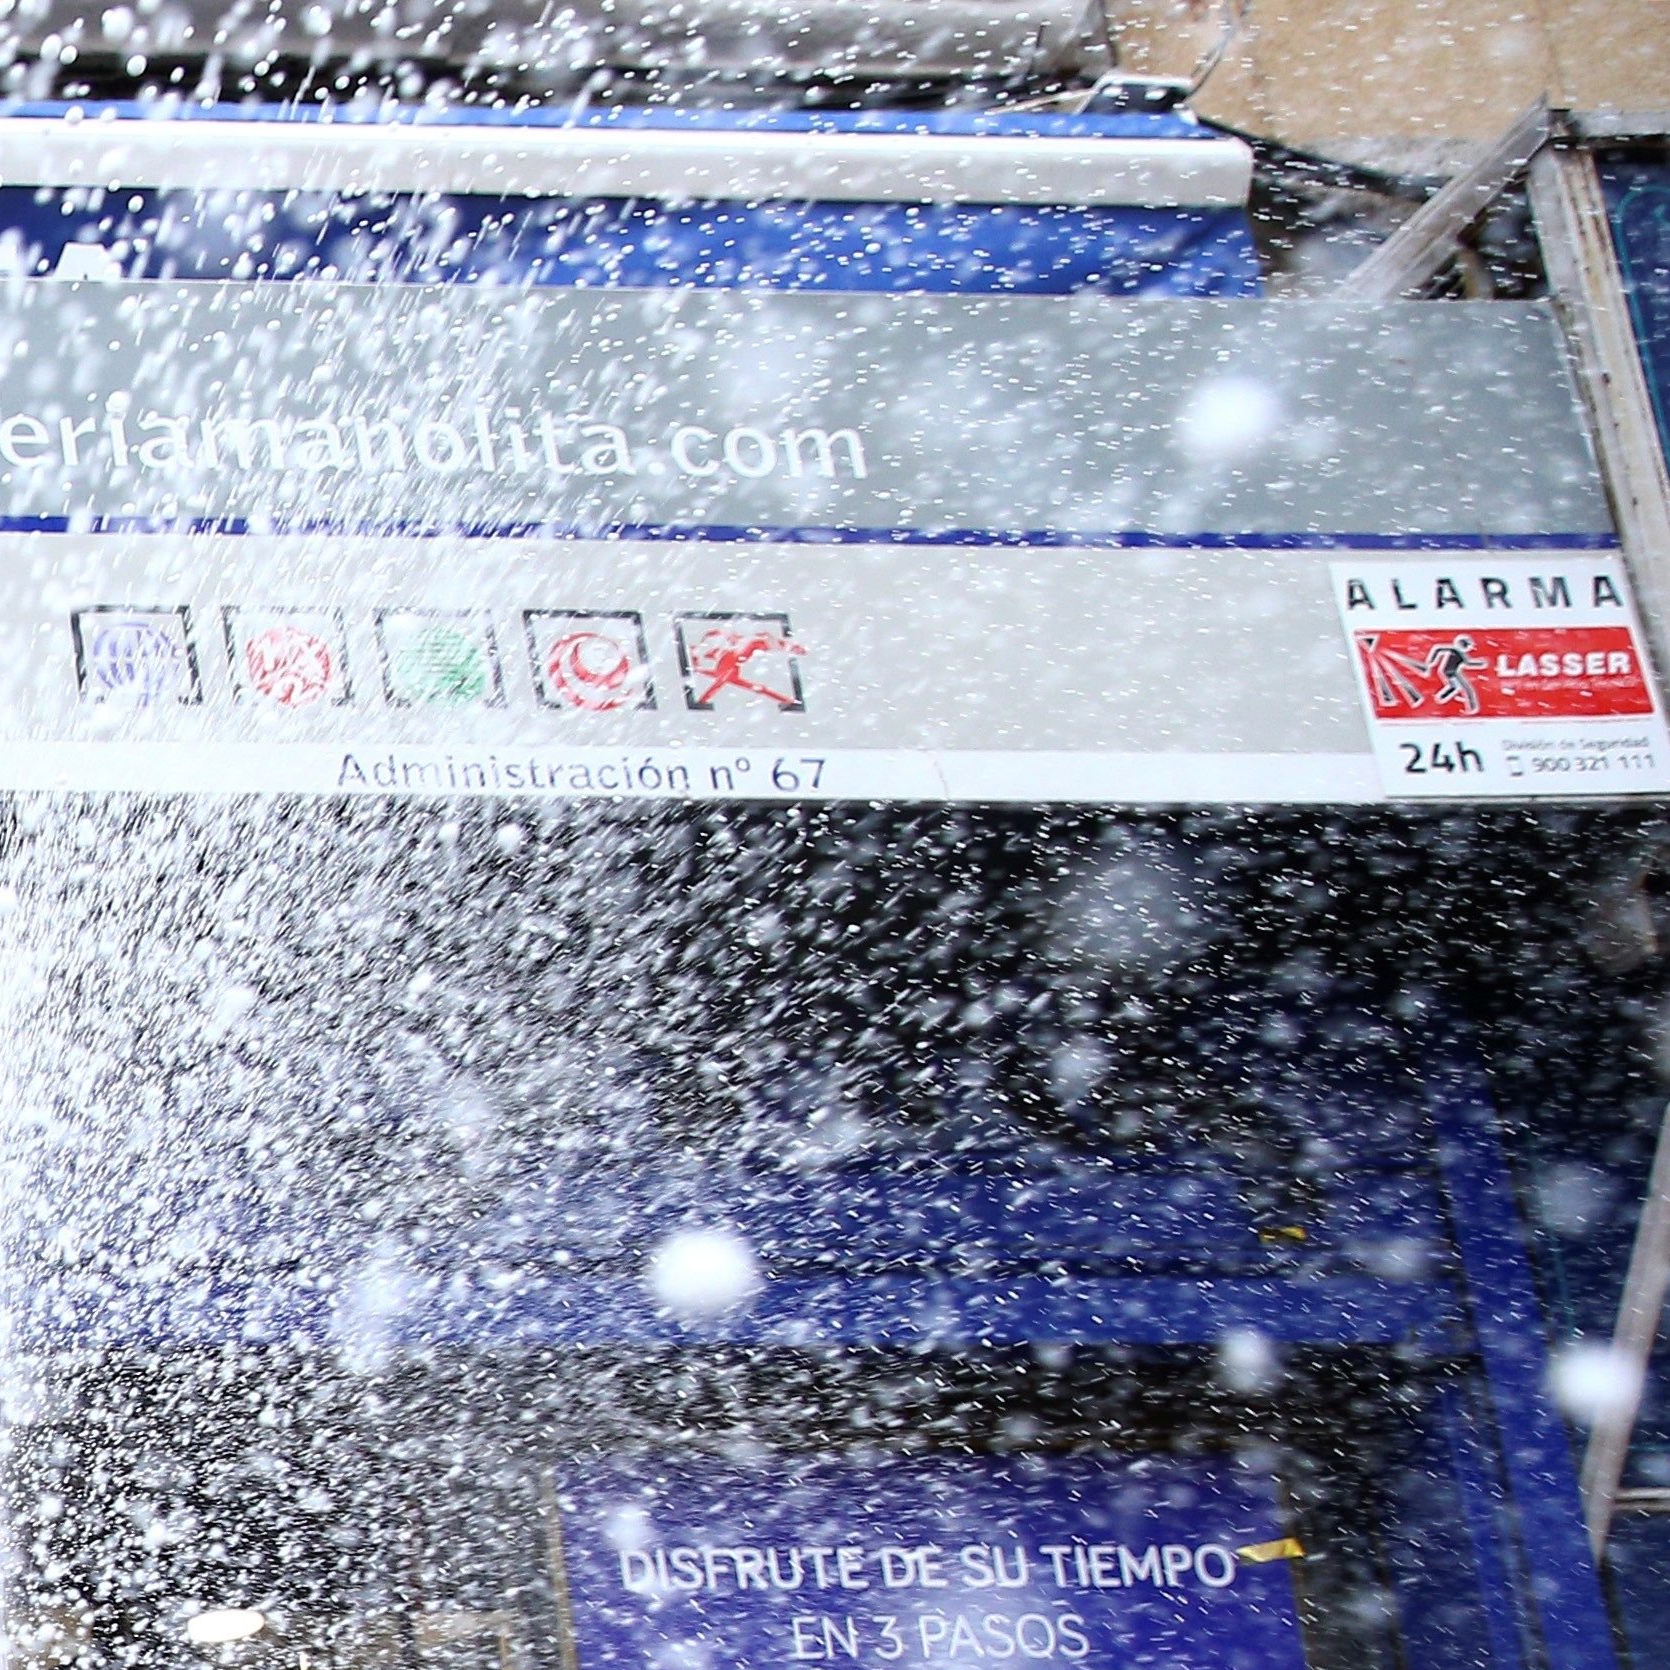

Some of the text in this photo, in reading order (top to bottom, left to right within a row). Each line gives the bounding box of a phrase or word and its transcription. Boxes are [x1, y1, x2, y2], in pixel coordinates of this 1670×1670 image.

[1346, 574, 1625, 611] ALARMA
[1496, 651, 1632, 678] LASSER
[336, 753, 690, 792] Administración
[771, 757, 827, 792] 67
[1399, 740, 1485, 775] 24h
[620, 1543, 1237, 1591] DISFRUTE DE SU TIEMPO
[790, 1612, 1091, 1661] EN 3 PASOS
